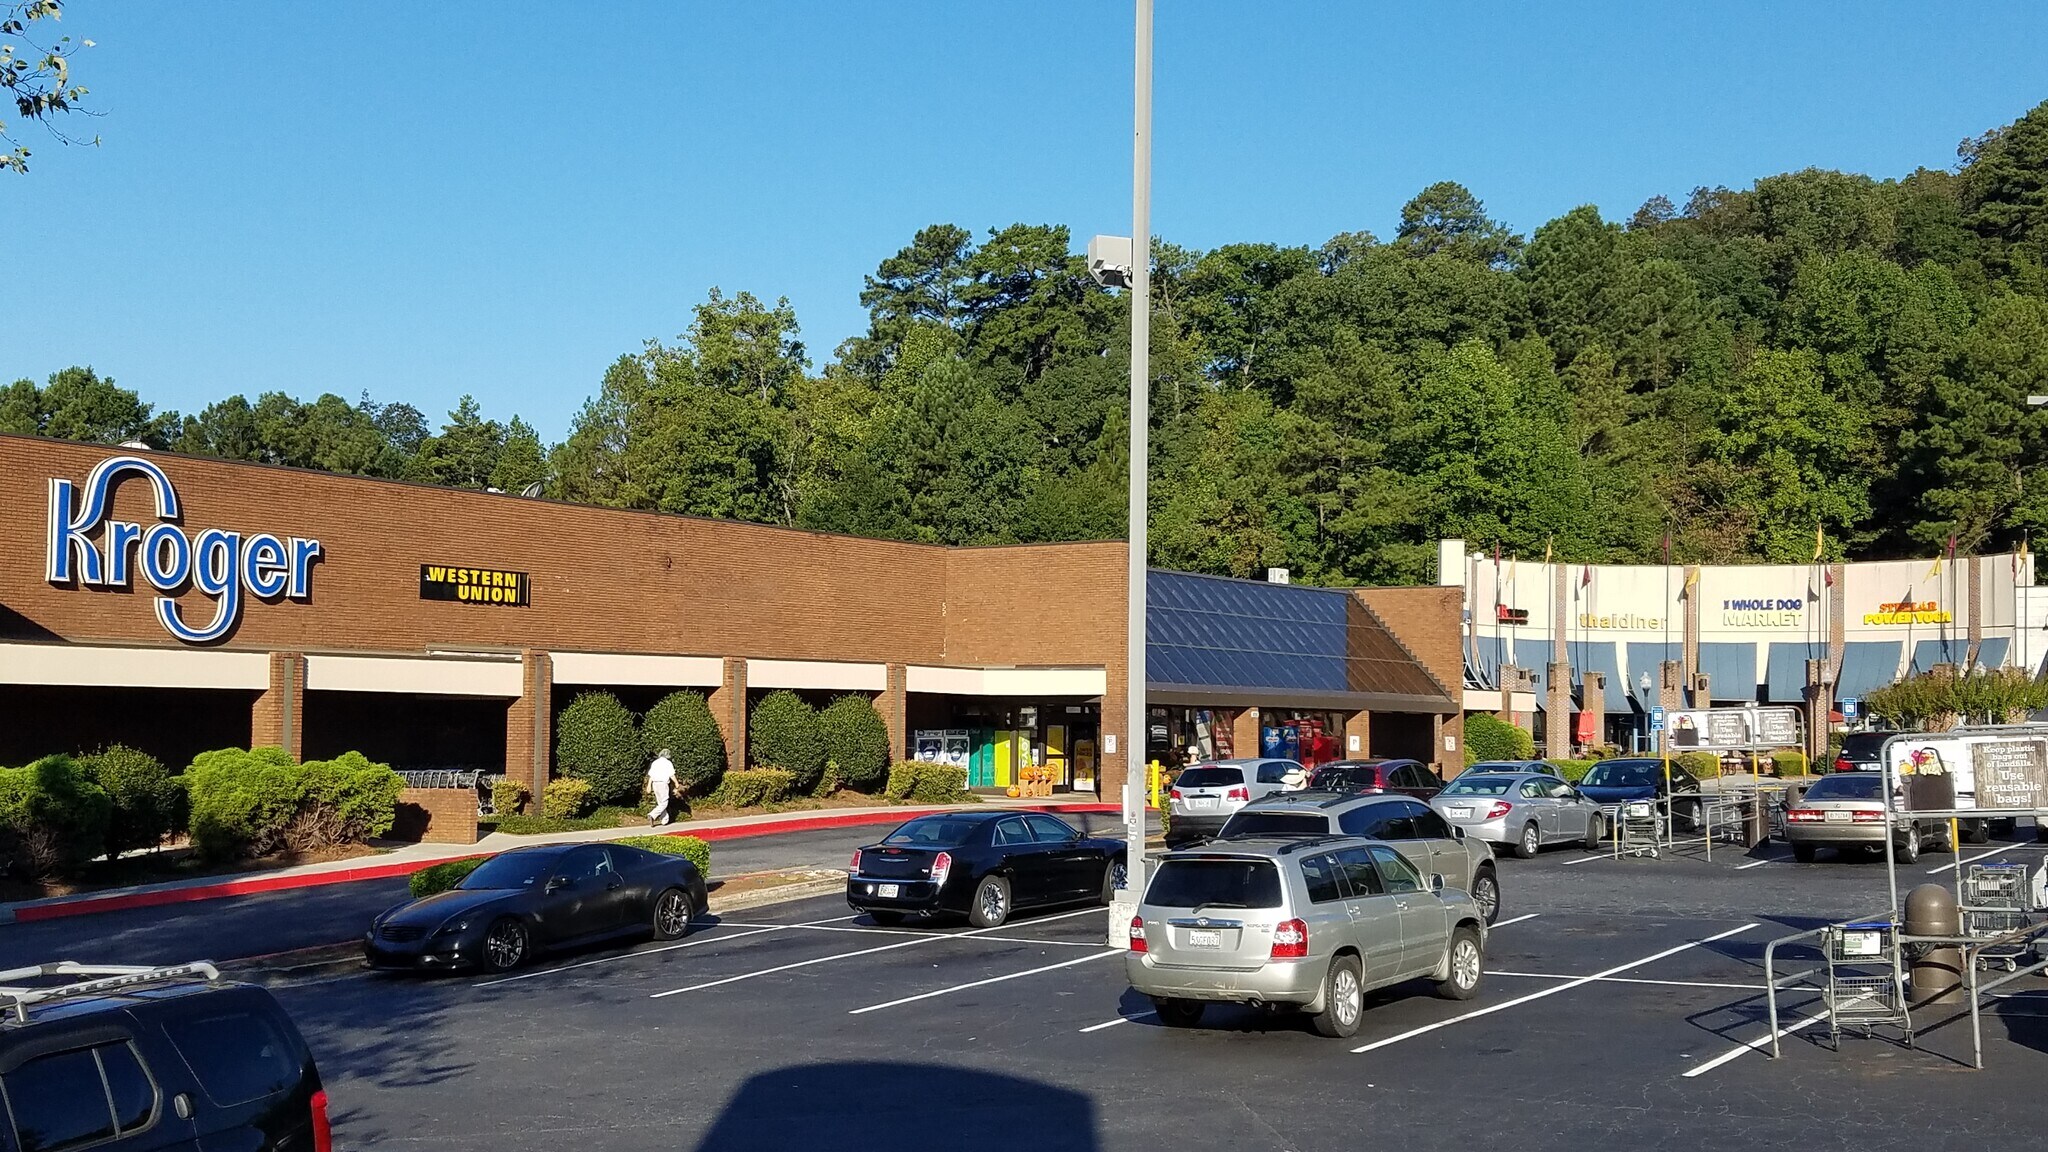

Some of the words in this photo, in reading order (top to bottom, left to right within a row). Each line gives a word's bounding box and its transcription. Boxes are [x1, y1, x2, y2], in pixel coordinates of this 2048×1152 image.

[45, 456, 320, 642] Kroger
[428, 566, 516, 588] WESTERN
[458, 585, 516, 603] UNION
[1732, 599, 1774, 611] WHOLE
[1776, 598, 1803, 611] DOG
[1723, 612, 1803, 627] MARKET
[1864, 611, 1913, 625] POWER
[1914, 610, 1952, 624] YOGA
[1982, 745, 2006, 755] Keep
[2006, 744, 2036, 754] plastic
[1992, 753, 2012, 761] bags
[2014, 752, 2028, 760] out
[1986, 760, 1996, 768] of
[1996, 759, 2034, 767] landfills.
[1999, 770, 2025, 780] Use
[1985, 781, 2042, 793] reusable
[1996, 792, 2032, 805] bags!
